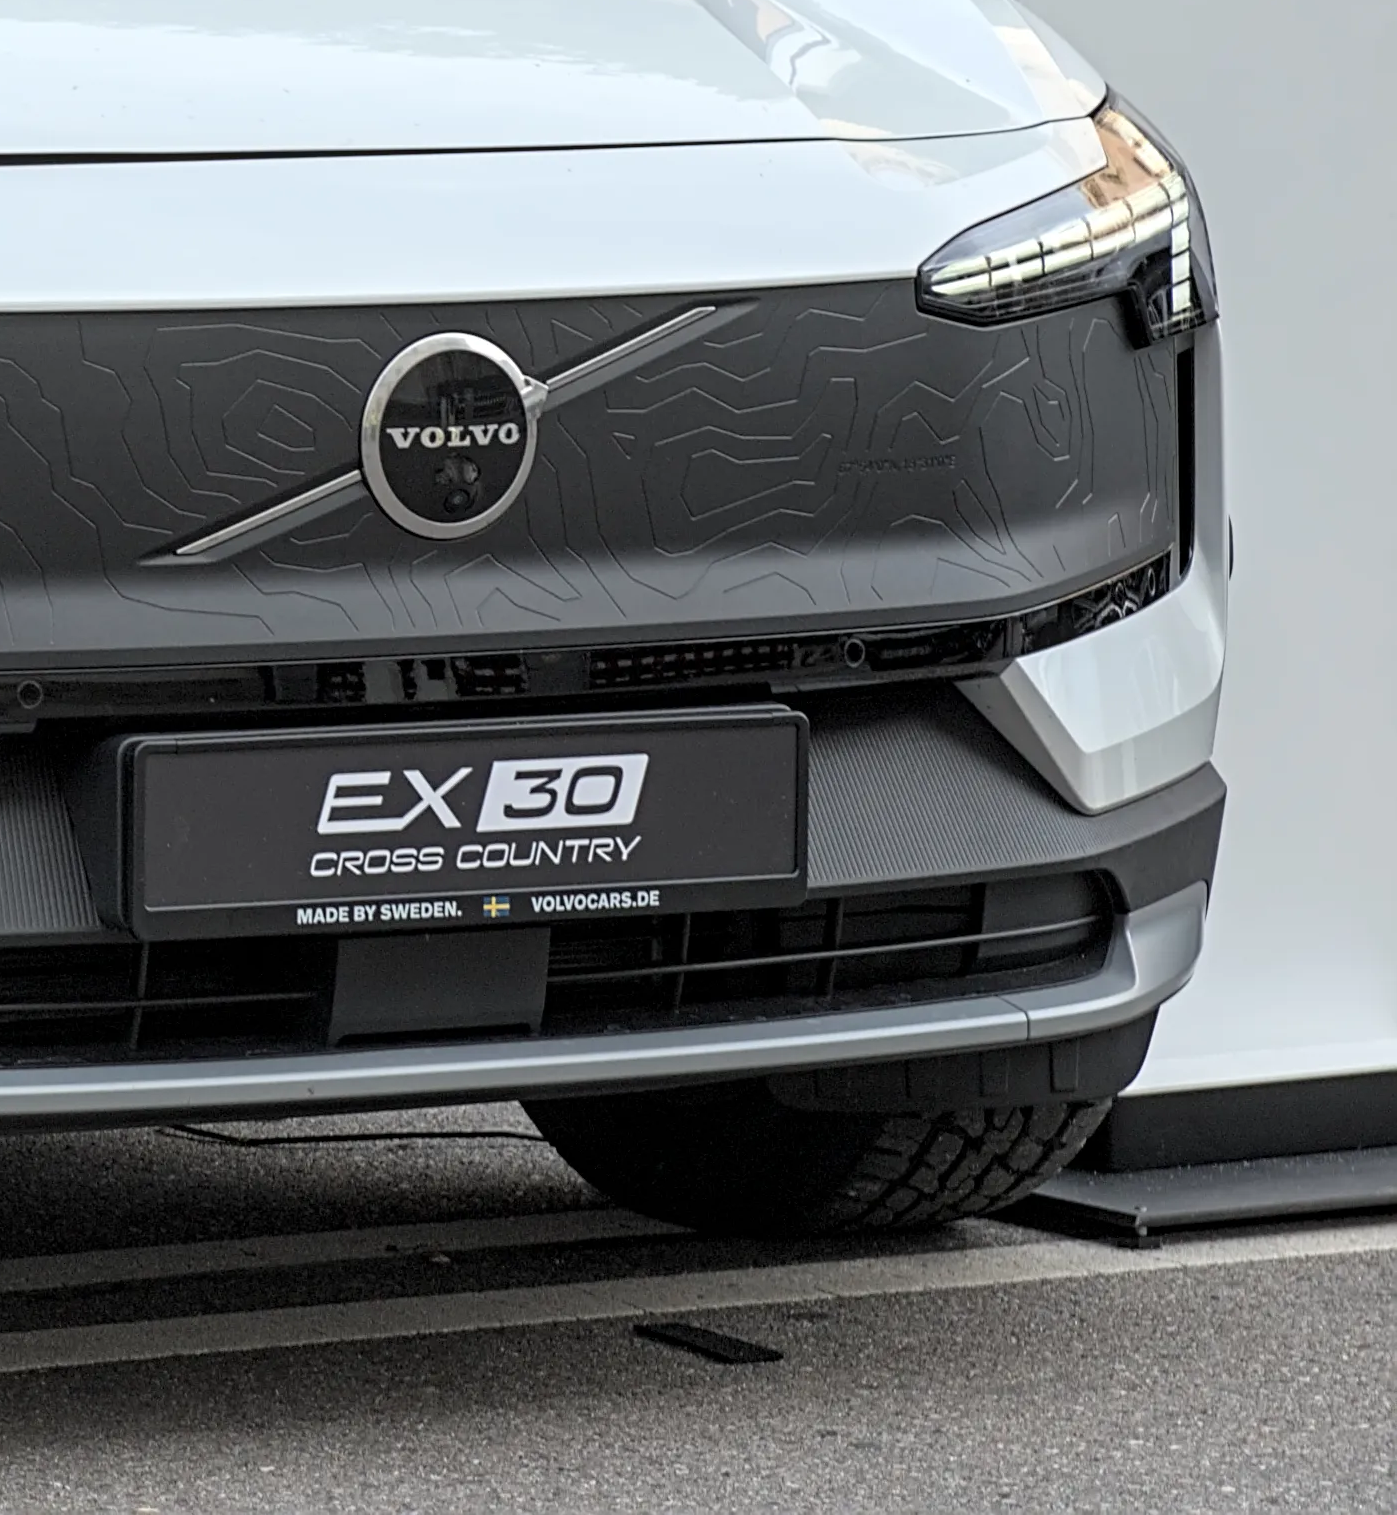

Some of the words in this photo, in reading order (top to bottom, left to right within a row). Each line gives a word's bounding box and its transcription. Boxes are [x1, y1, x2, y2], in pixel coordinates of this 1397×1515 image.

[386, 422, 520, 449] VOLVO
[316, 766, 473, 835] EX
[503, 765, 625, 819] 30
[309, 846, 445, 878] CROSS
[456, 835, 642, 870] COUNTRY
[296, 906, 350, 925] MADE
[353, 904, 377, 922] BY
[380, 900, 463, 921] SWEDEN.
[530, 889, 661, 913] VOLVOCARS.DE
